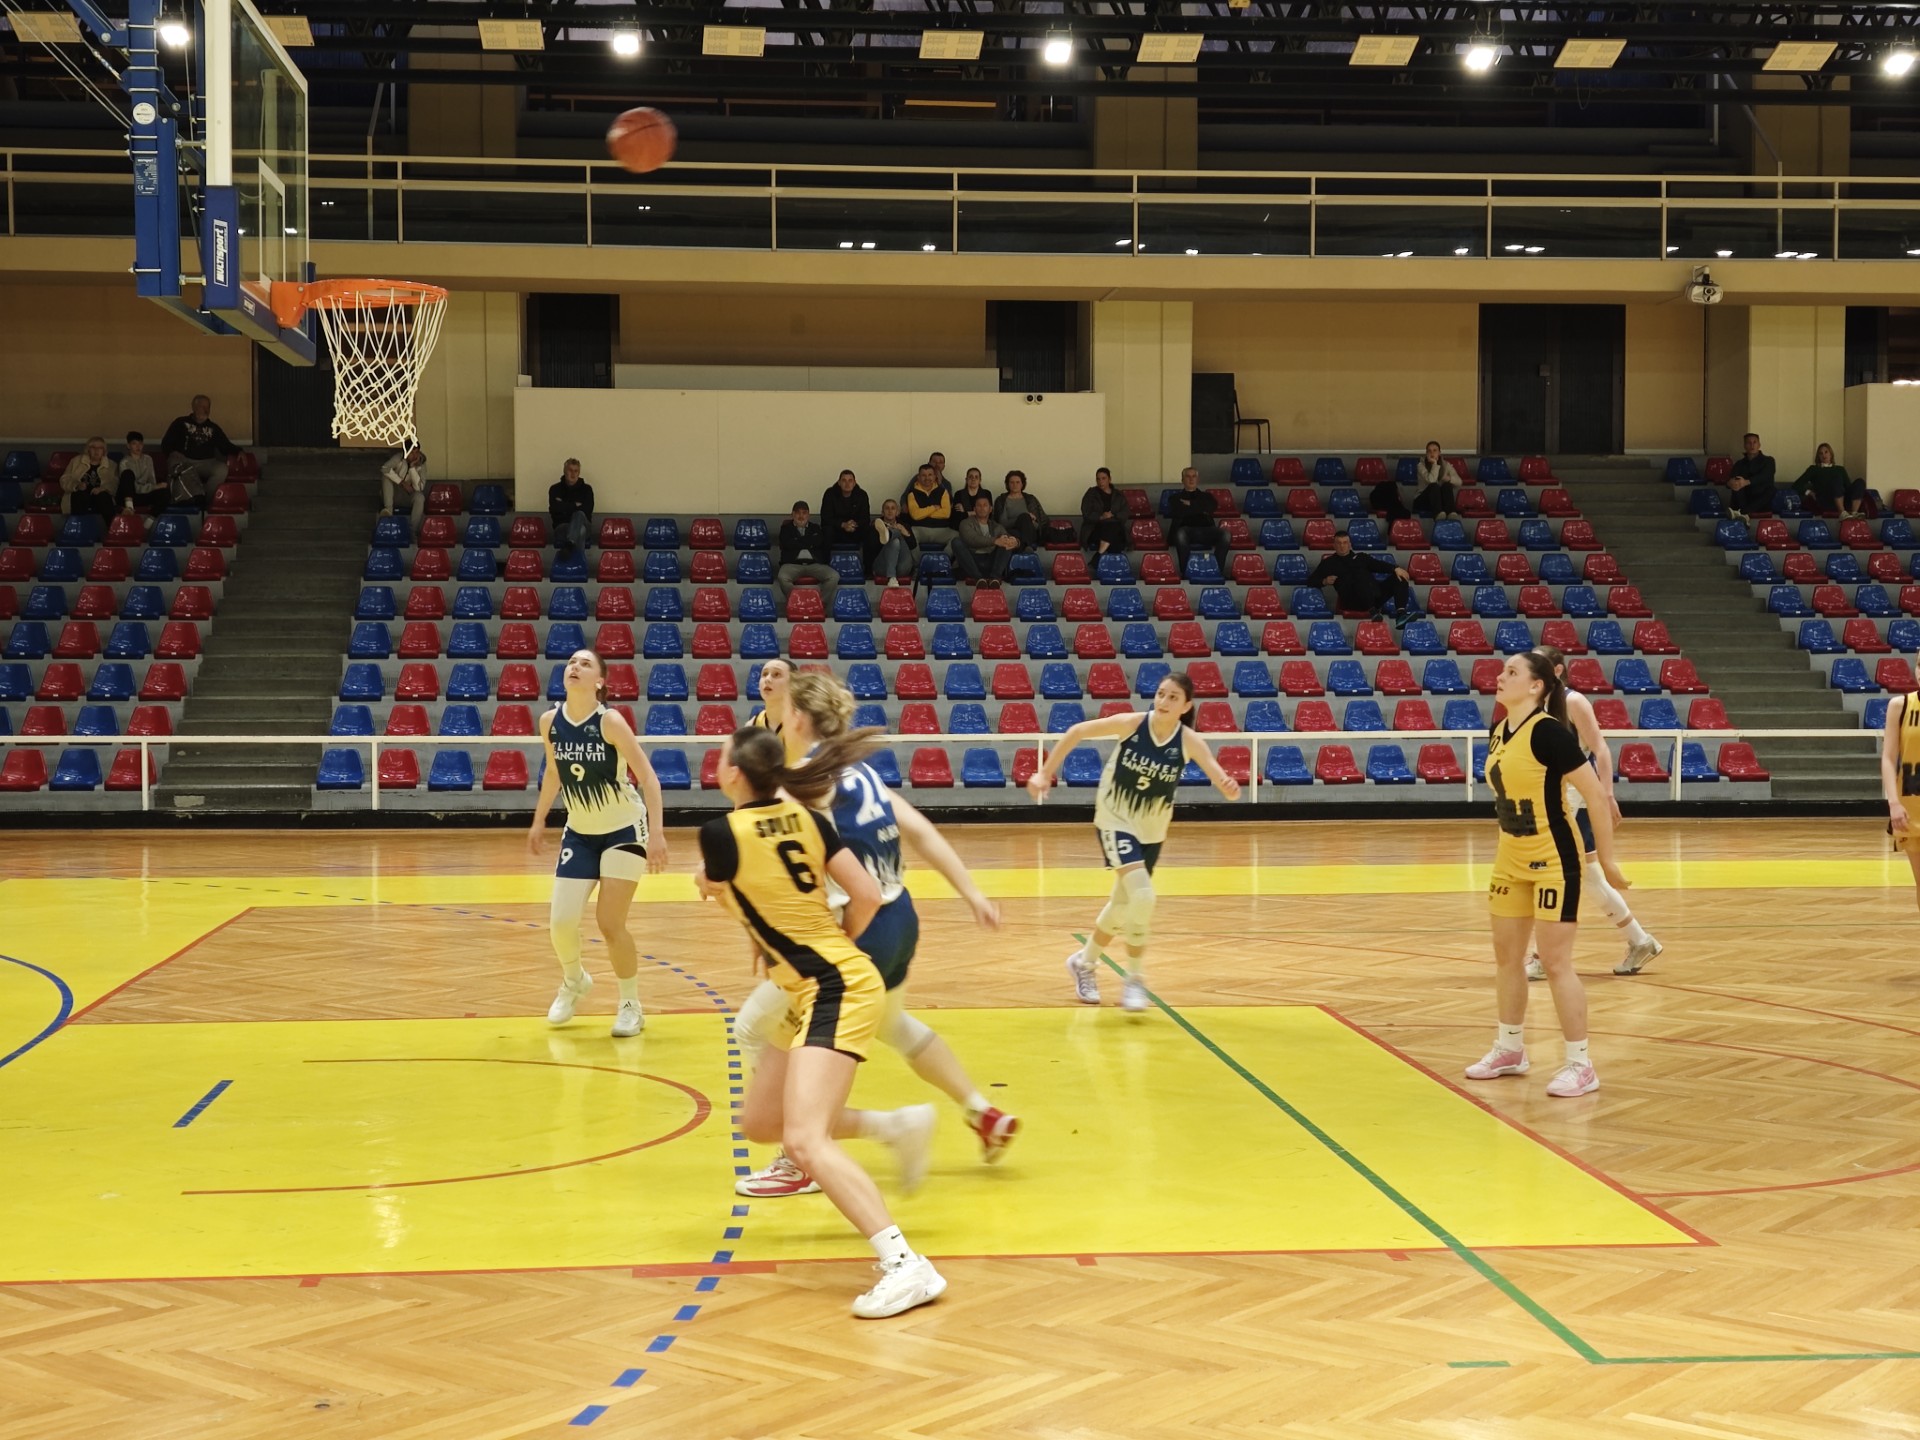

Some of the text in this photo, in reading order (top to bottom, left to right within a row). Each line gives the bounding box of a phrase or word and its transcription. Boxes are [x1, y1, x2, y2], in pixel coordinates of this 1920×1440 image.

[585, 751, 606, 762] VITI
[570, 763, 586, 782] 9
[1136, 775, 1151, 791] 5
[560, 847, 574, 865] 9
[1117, 839, 1134, 855] 5
[776, 840, 818, 894] 6
[1538, 887, 1558, 910] 10
